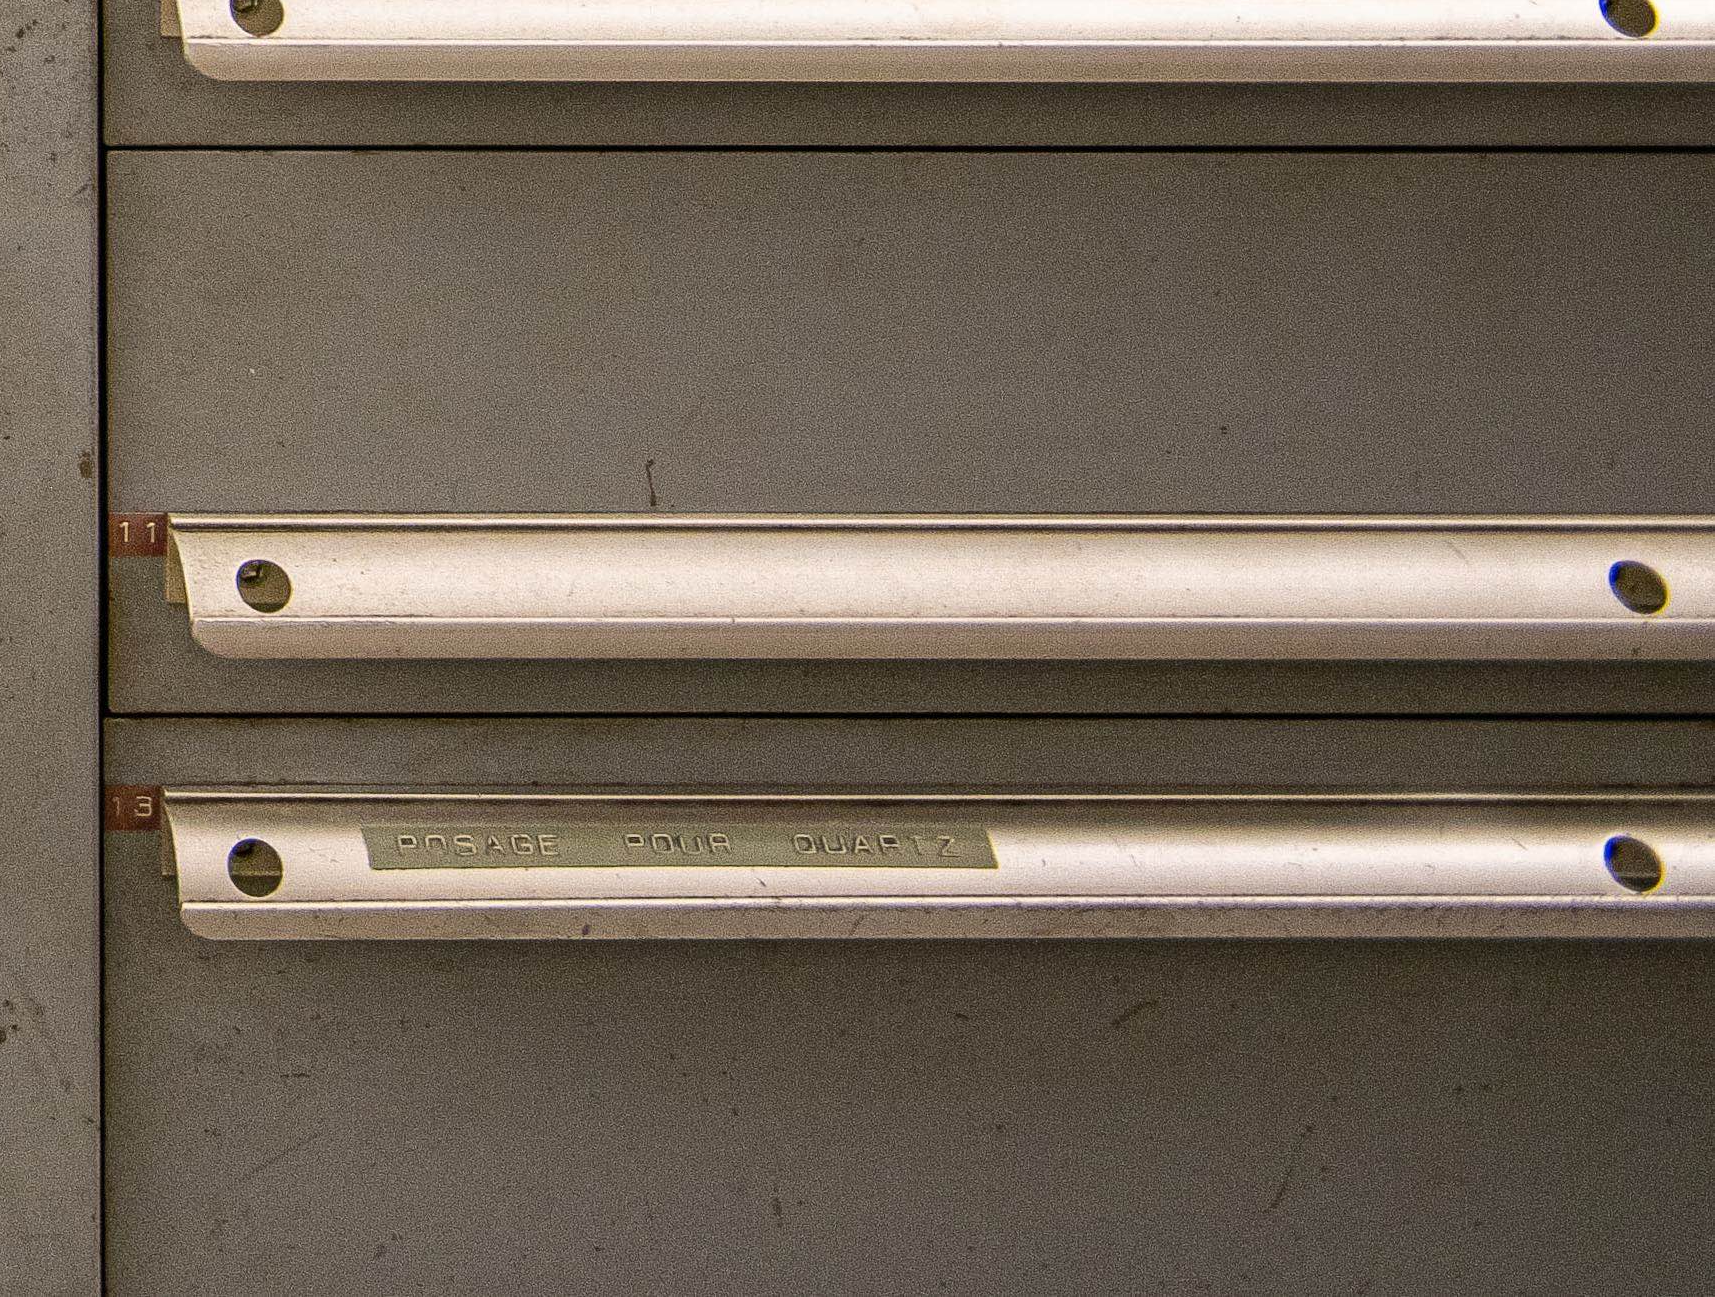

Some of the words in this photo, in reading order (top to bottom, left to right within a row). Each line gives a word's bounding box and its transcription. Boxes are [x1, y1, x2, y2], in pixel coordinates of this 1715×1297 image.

[119, 520, 156, 544] 11
[112, 795, 153, 819] 13
[396, 833, 560, 856] POSAGE
[623, 832, 733, 856] POUR
[791, 832, 960, 859] QUARTZ
